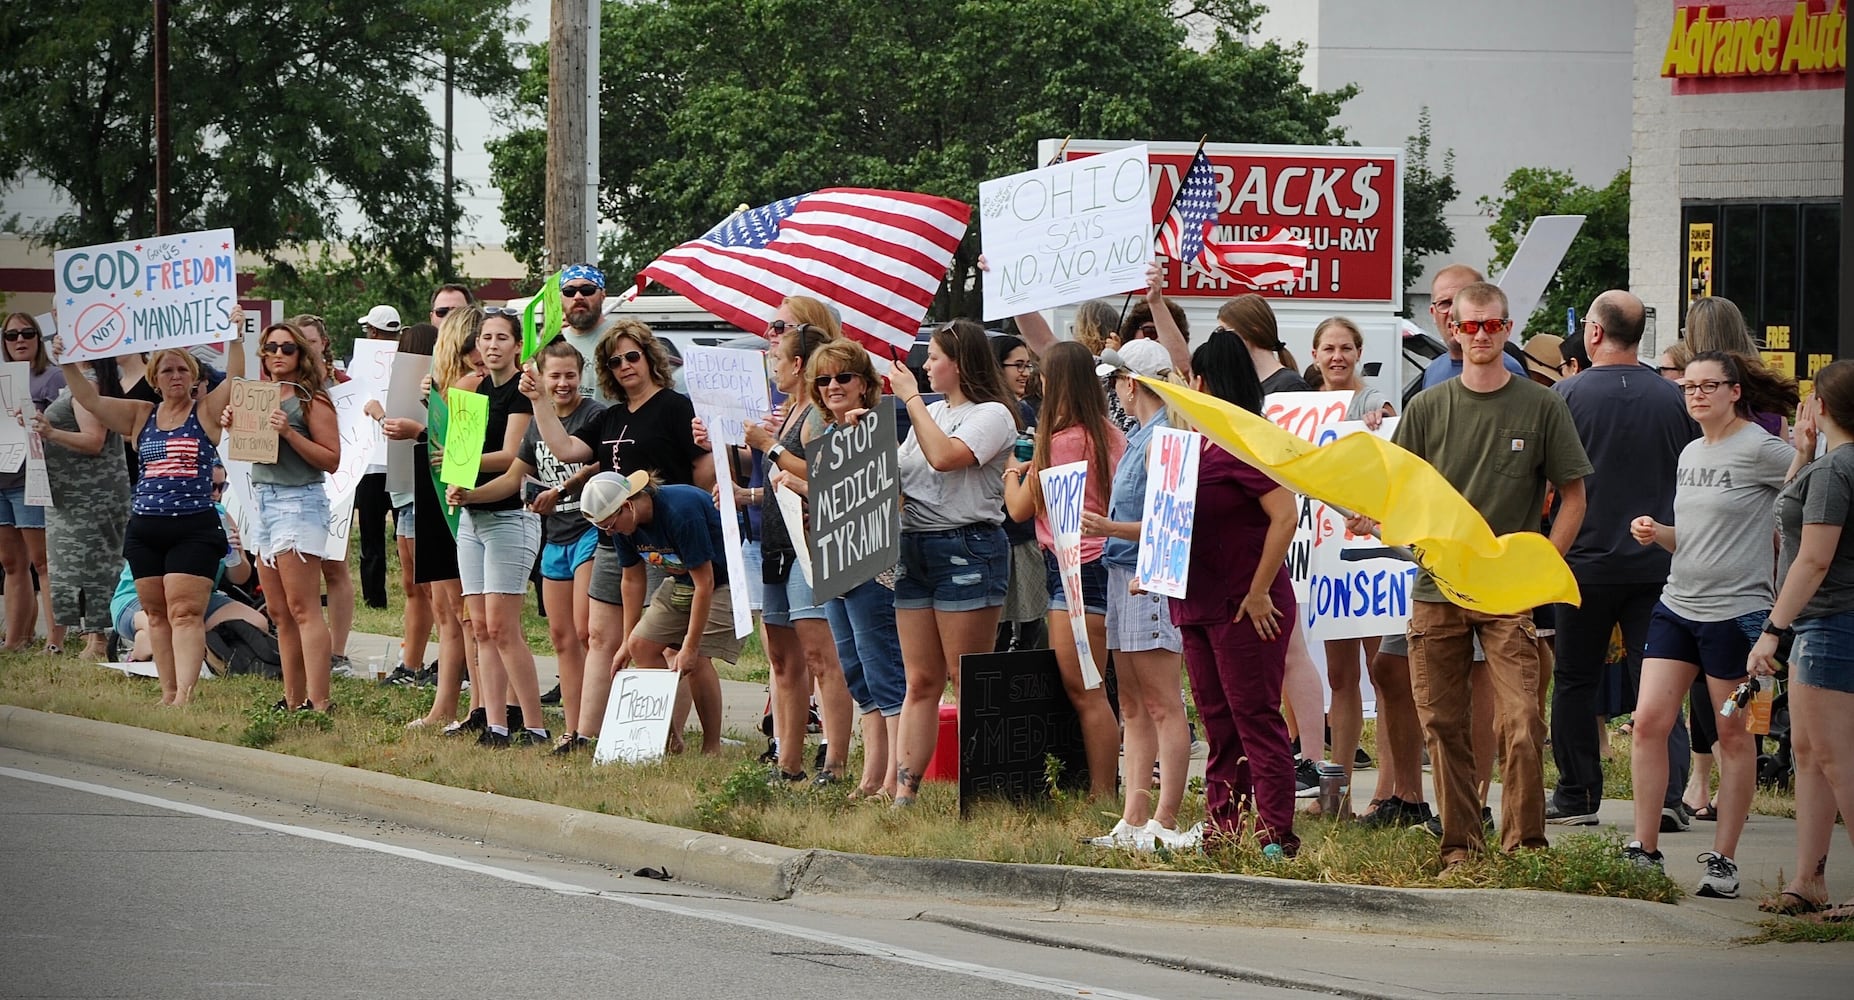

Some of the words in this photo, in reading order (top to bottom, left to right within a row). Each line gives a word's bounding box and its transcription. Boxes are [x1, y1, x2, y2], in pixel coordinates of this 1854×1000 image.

[1662, 5, 1781, 76] Advance
[1012, 157, 1146, 222] OHIO
[1046, 214, 1105, 251] SAYS
[1292, 227, 1379, 251] BLU-RAY
[63, 250, 140, 295] GOD
[146, 255, 232, 291] FREEDOM
[1000, 254, 1044, 298] NO,
[1049, 249, 1100, 285] NO,
[1104, 223, 1150, 272] NO!
[91, 318, 116, 345] NOT
[133, 296, 231, 342] MANDATES
[686, 351, 753, 373] MEDICAL
[687, 371, 754, 394] FREEDOM
[246, 388, 276, 413] STOP
[232, 433, 248, 450] NOT
[829, 411, 879, 471] STOP
[1160, 433, 1192, 492] 40%
[816, 451, 894, 532] MEDICAL
[1677, 467, 1733, 489] MAMA
[817, 498, 892, 580] TYRANNY
[615, 675, 670, 721] FREEDOM
[974, 670, 1002, 717] I
